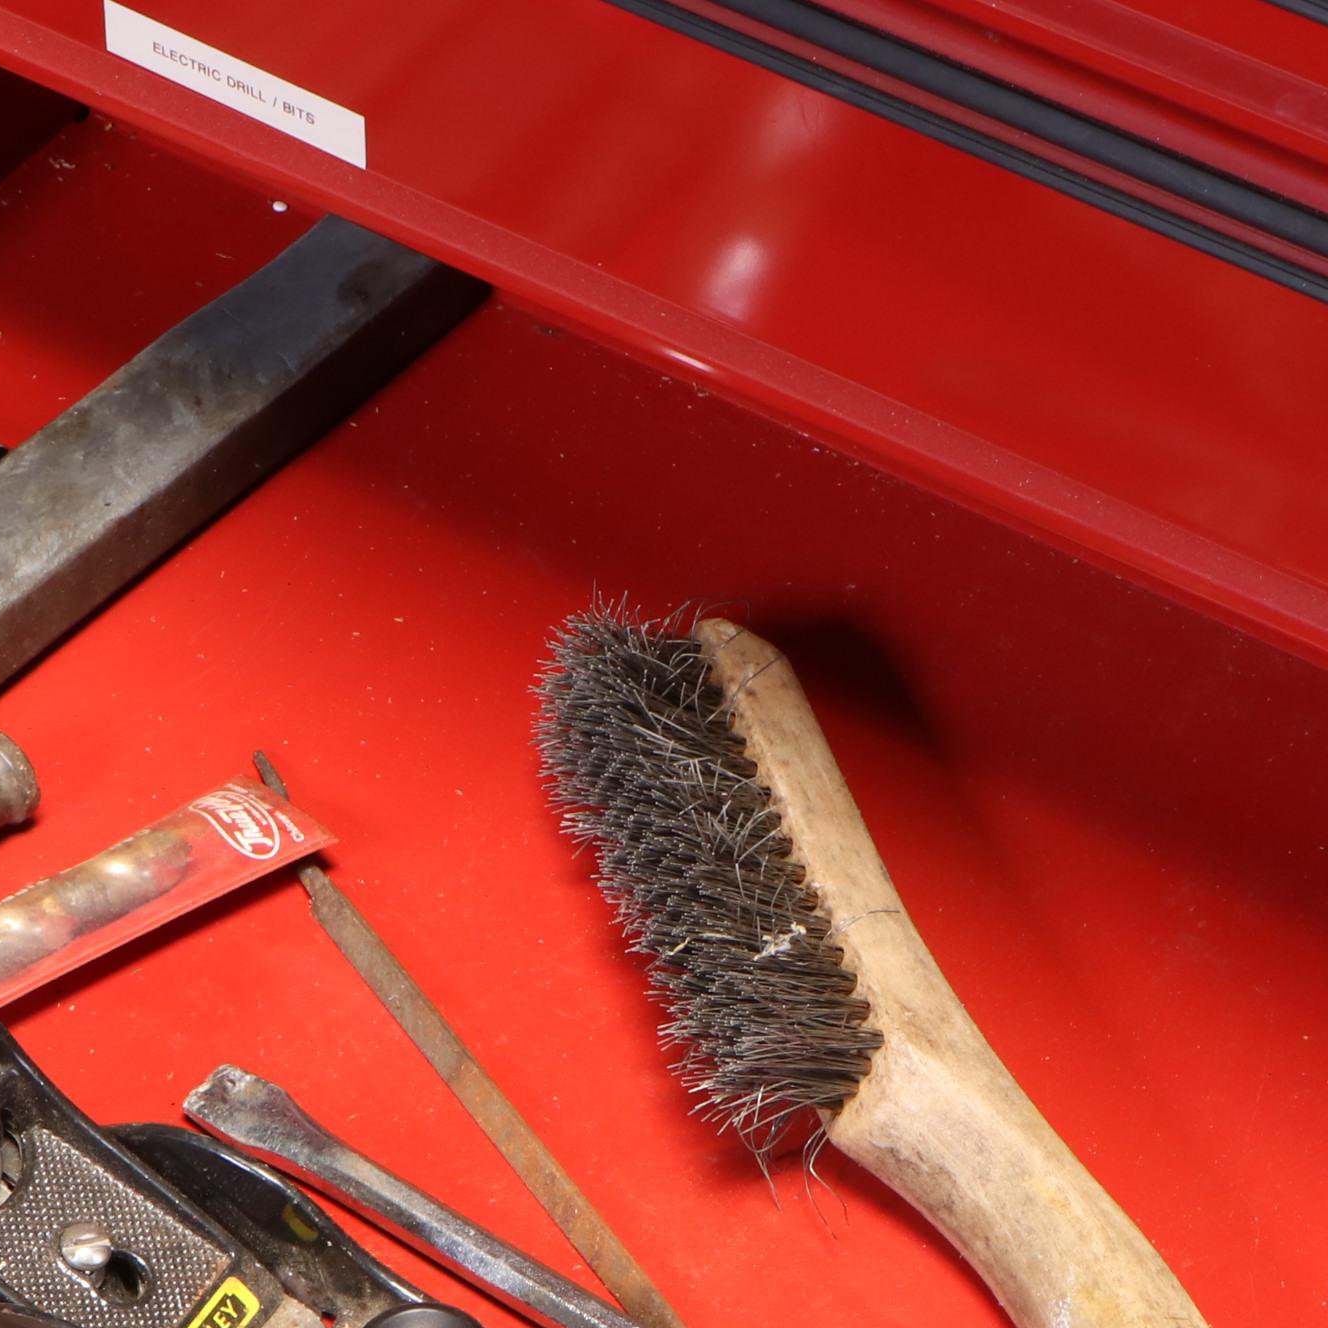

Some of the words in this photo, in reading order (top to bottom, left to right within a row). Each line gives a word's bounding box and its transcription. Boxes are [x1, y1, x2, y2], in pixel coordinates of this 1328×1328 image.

[151, 40, 222, 83] ELECTRIC
[226, 75, 267, 104] DRILL
[282, 100, 316, 126] BITS
